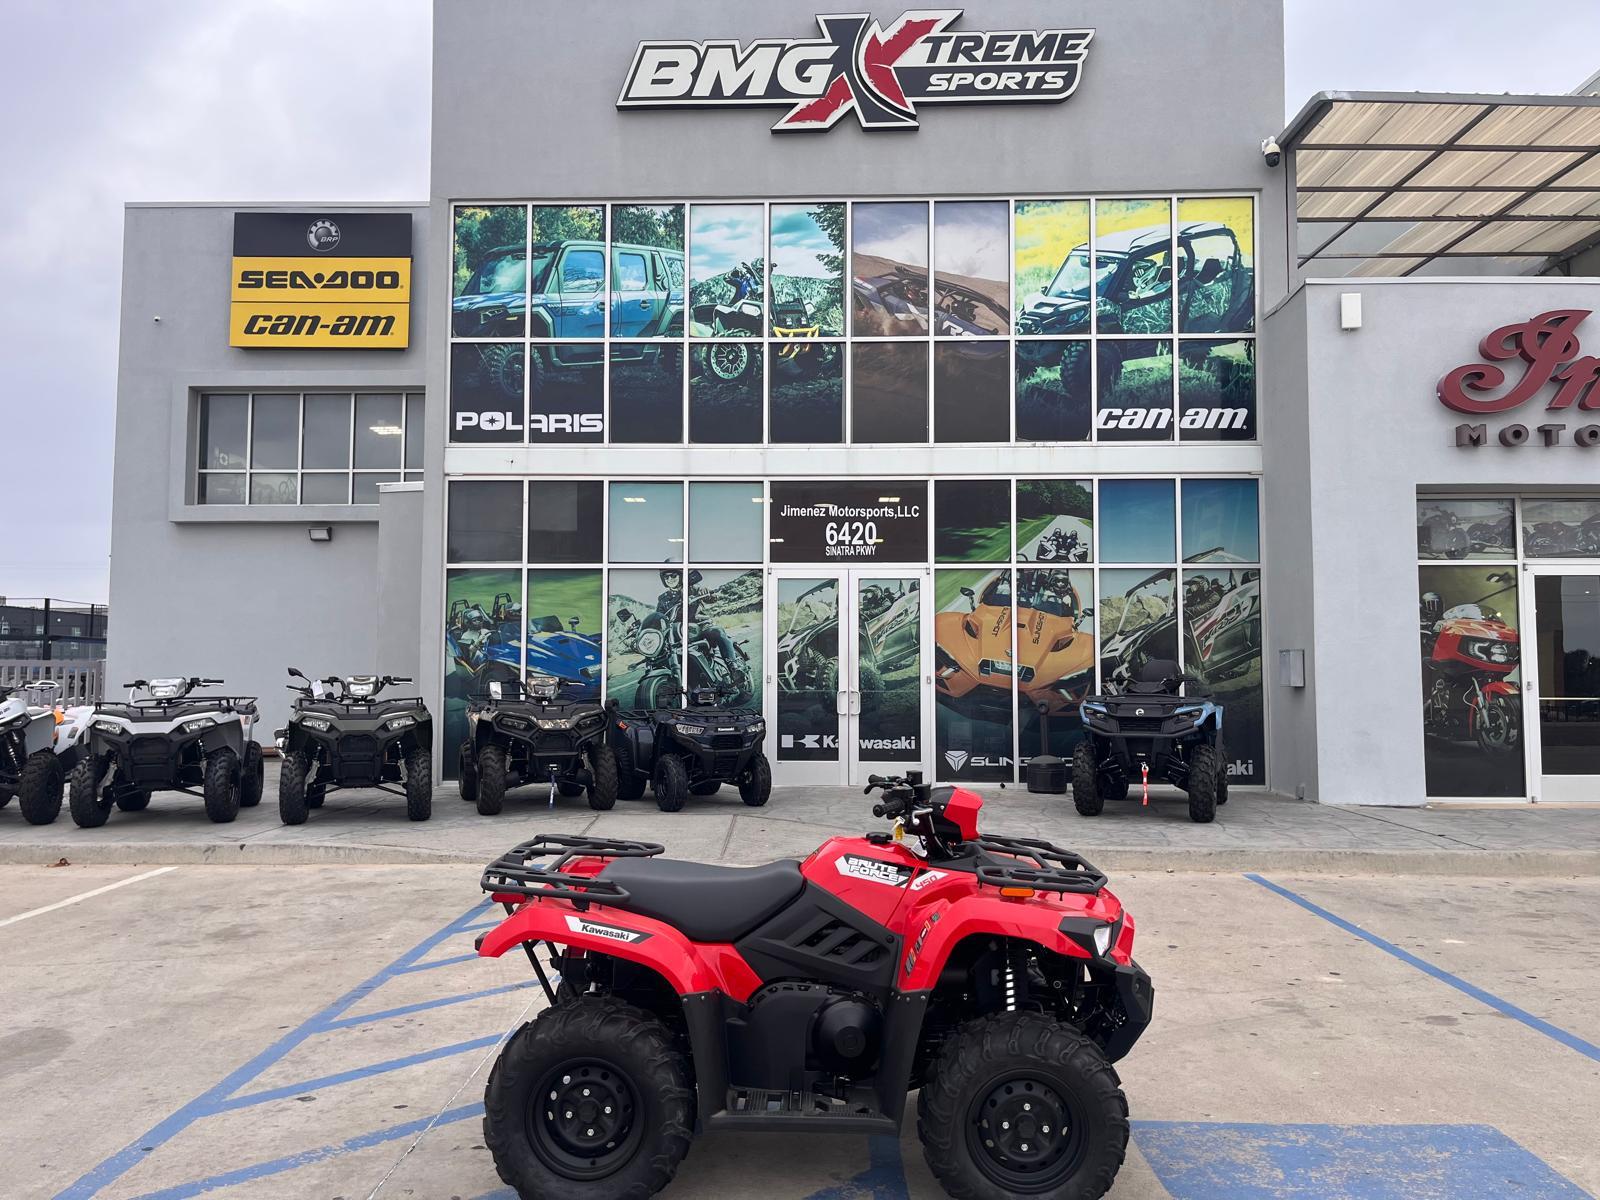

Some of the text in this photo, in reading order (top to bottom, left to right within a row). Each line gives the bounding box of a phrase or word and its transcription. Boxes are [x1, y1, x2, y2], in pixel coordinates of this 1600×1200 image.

[627, 45, 840, 98] BMG
[926, 71, 1068, 91] SPORTS
[243, 315, 396, 336] can-am
[456, 411, 603, 433] POLARIS
[780, 505, 826, 517] Jimenez
[825, 521, 877, 545] 6420
[825, 546, 876, 556] SINATRA PKWY
[848, 858, 898, 874] BRUTE
[849, 865, 899, 882] FORCE
[581, 924, 630, 940] Kawasaki
